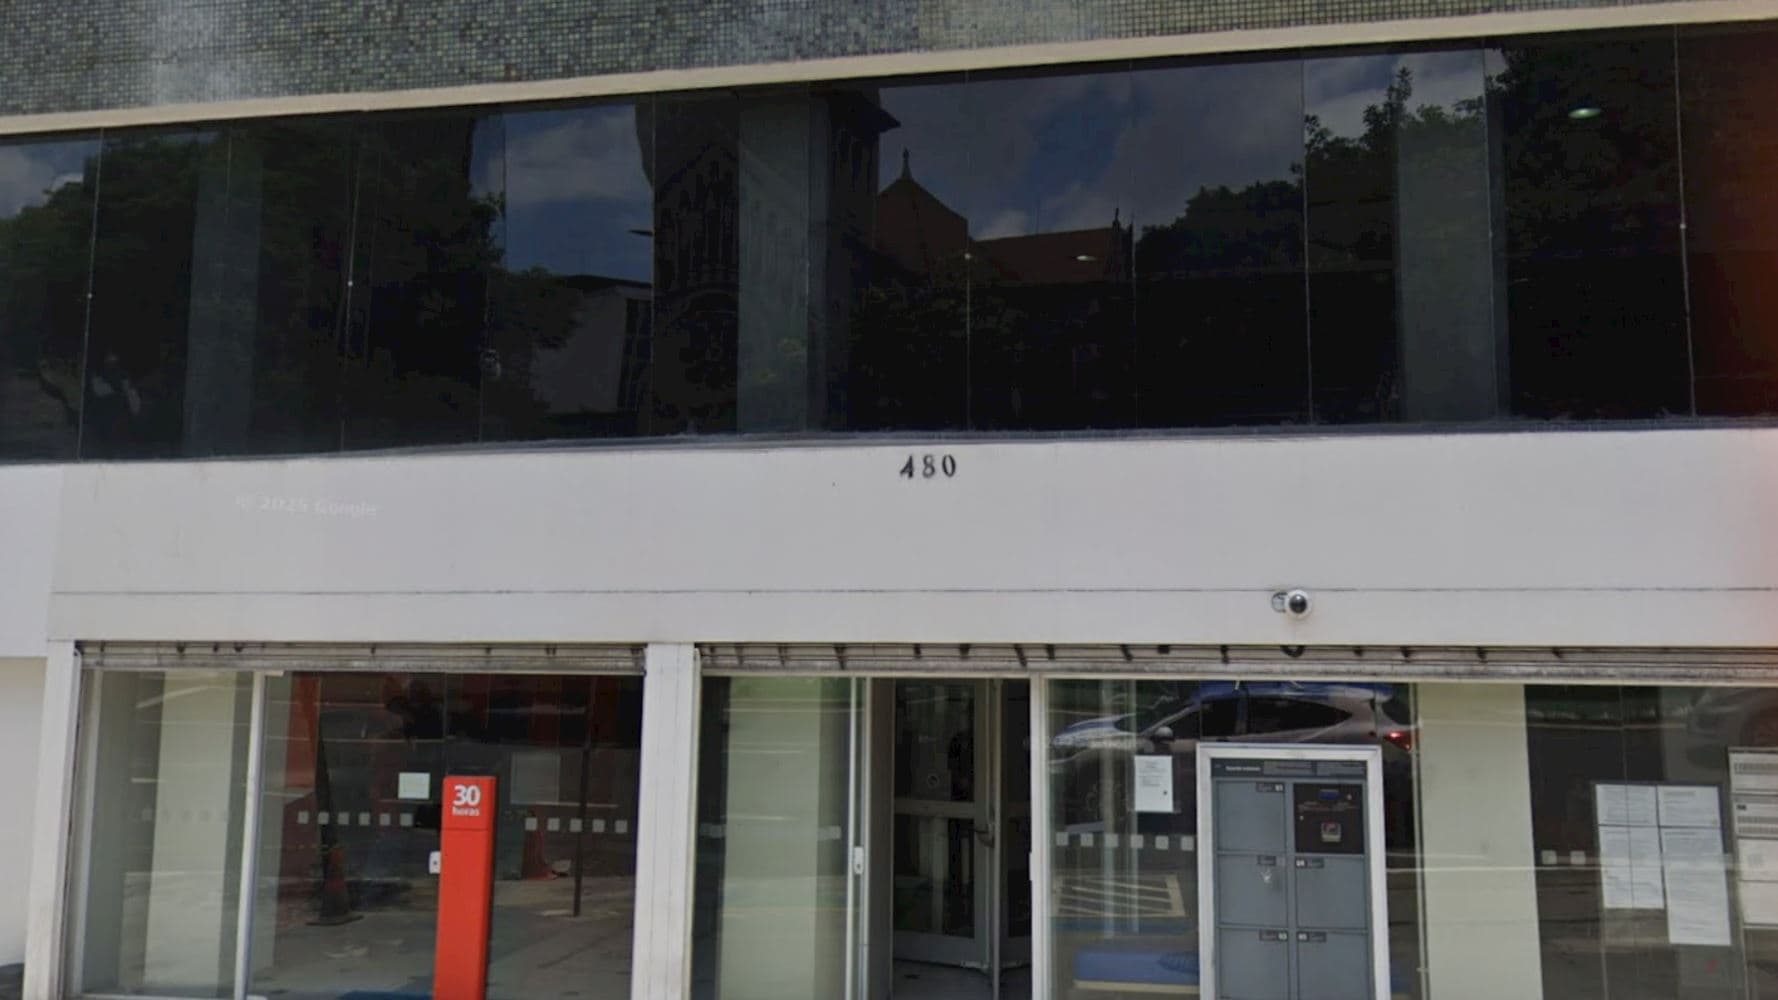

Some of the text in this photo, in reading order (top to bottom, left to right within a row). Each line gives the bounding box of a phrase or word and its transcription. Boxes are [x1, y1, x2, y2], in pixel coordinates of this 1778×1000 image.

[900, 454, 957, 478] 480
[453, 784, 481, 806] 30
[452, 805, 480, 817] horas
